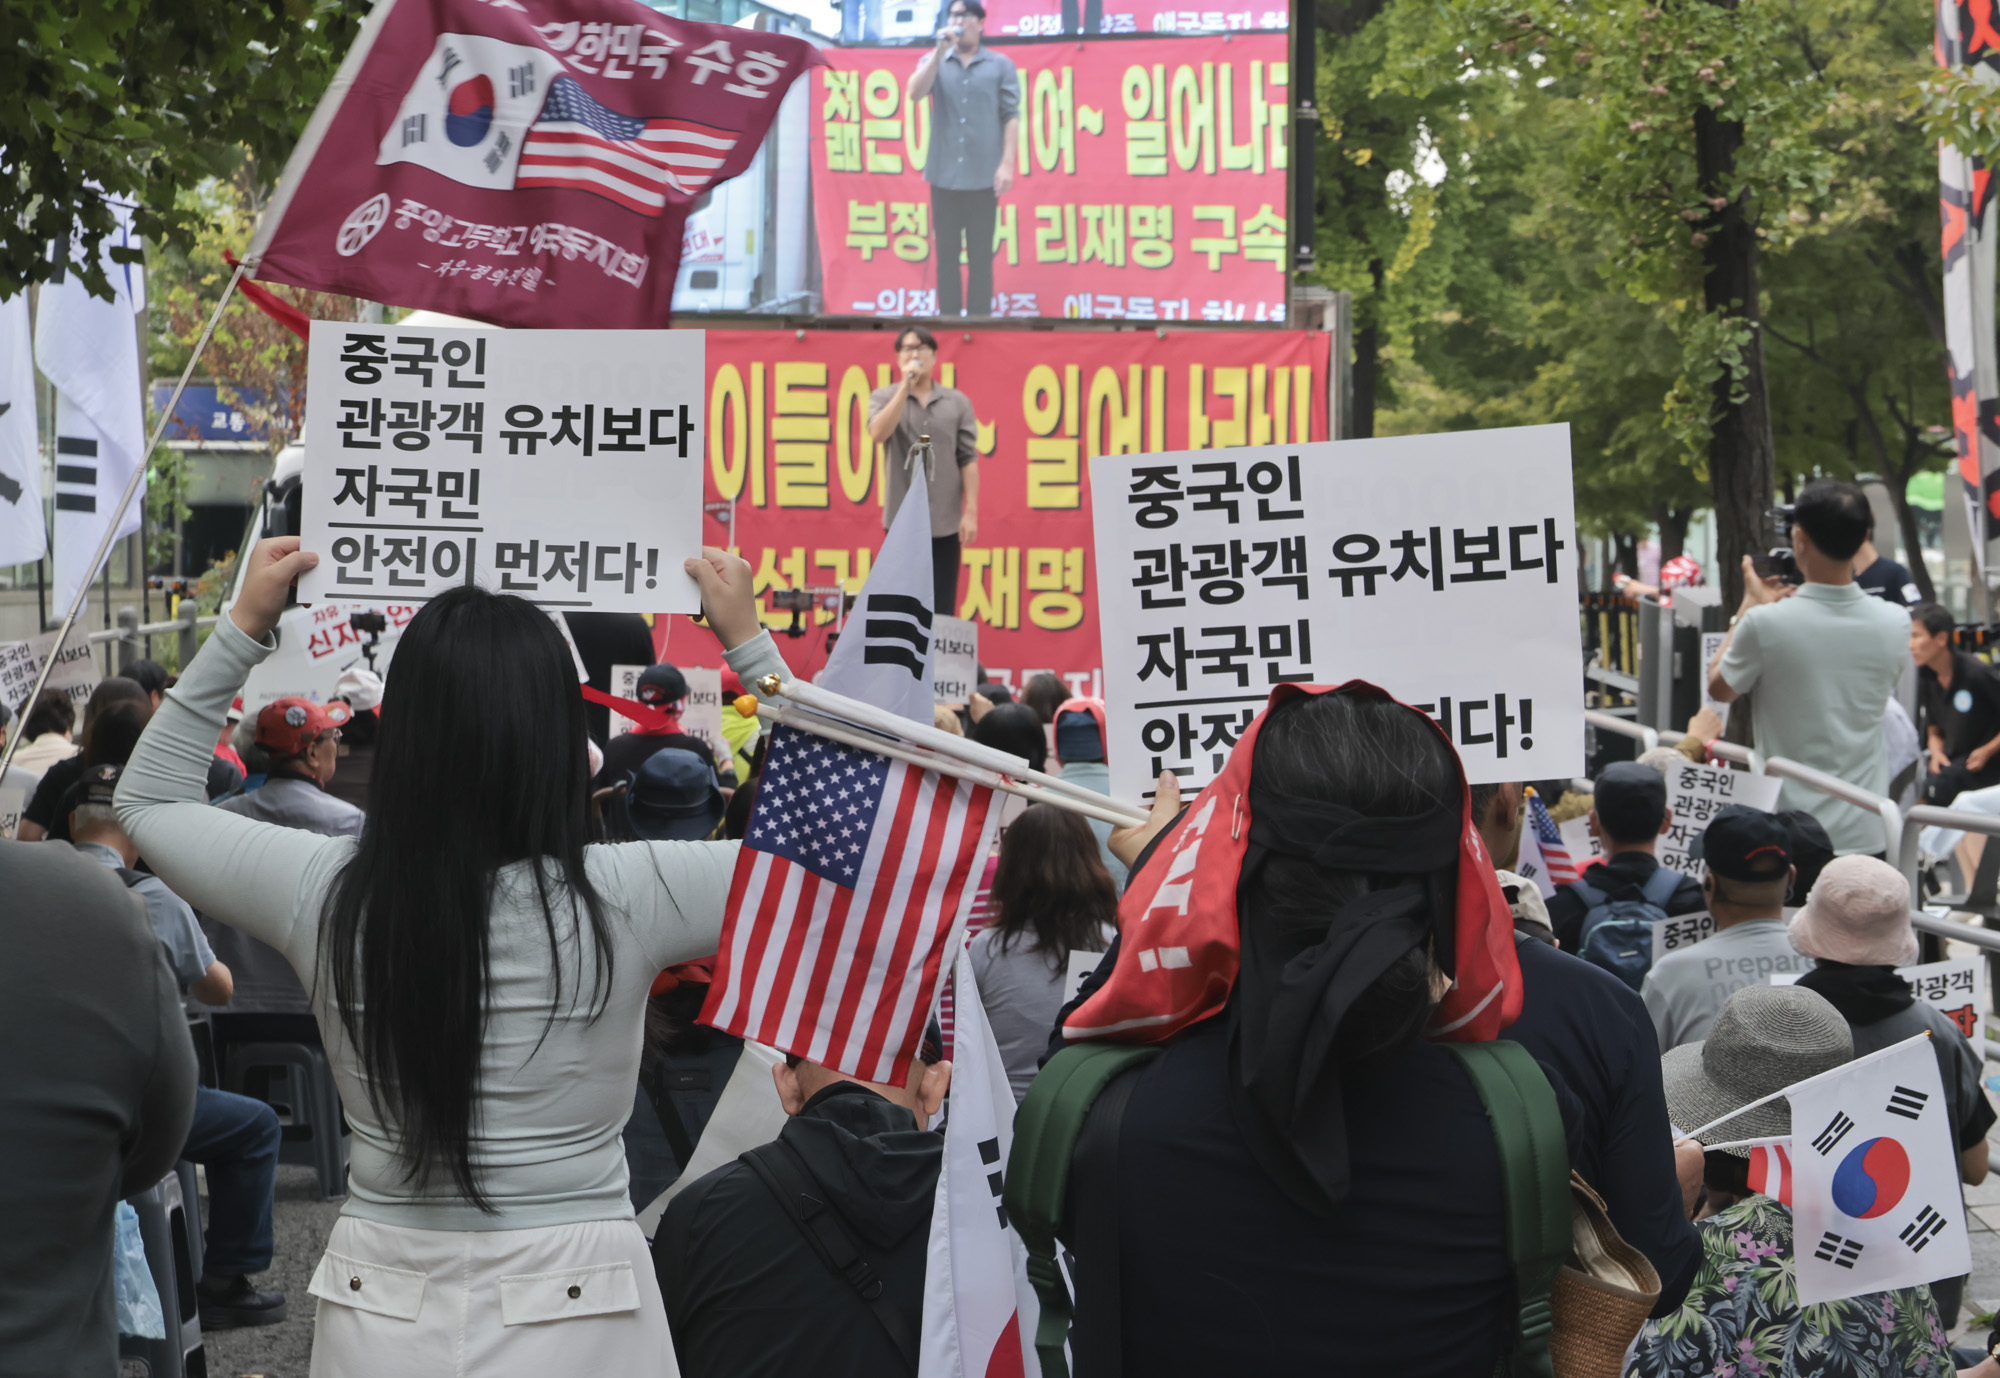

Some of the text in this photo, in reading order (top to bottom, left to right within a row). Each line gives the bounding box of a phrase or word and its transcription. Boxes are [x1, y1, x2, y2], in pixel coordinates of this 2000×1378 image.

[684, 39, 788, 98] 수호
[1035, 203, 1174, 269] 리재명
[1191, 203, 1287, 272] 구속
[340, 333, 486, 389] 중국인
[336, 398, 694, 457] 관광객 유치보다
[333, 465, 480, 519] 자국민
[1128, 455, 1304, 529] 중국인
[331, 534, 659, 594] 안전이 먼저다!
[961, 547, 1084, 630] 재명
[1132, 518, 1564, 609] 관광객 유치보다
[934, 639, 974, 658] 치보다
[1136, 619, 1314, 691] 자국민
[934, 681, 967, 697] 저다!
[1680, 766, 1735, 797] 중국인
